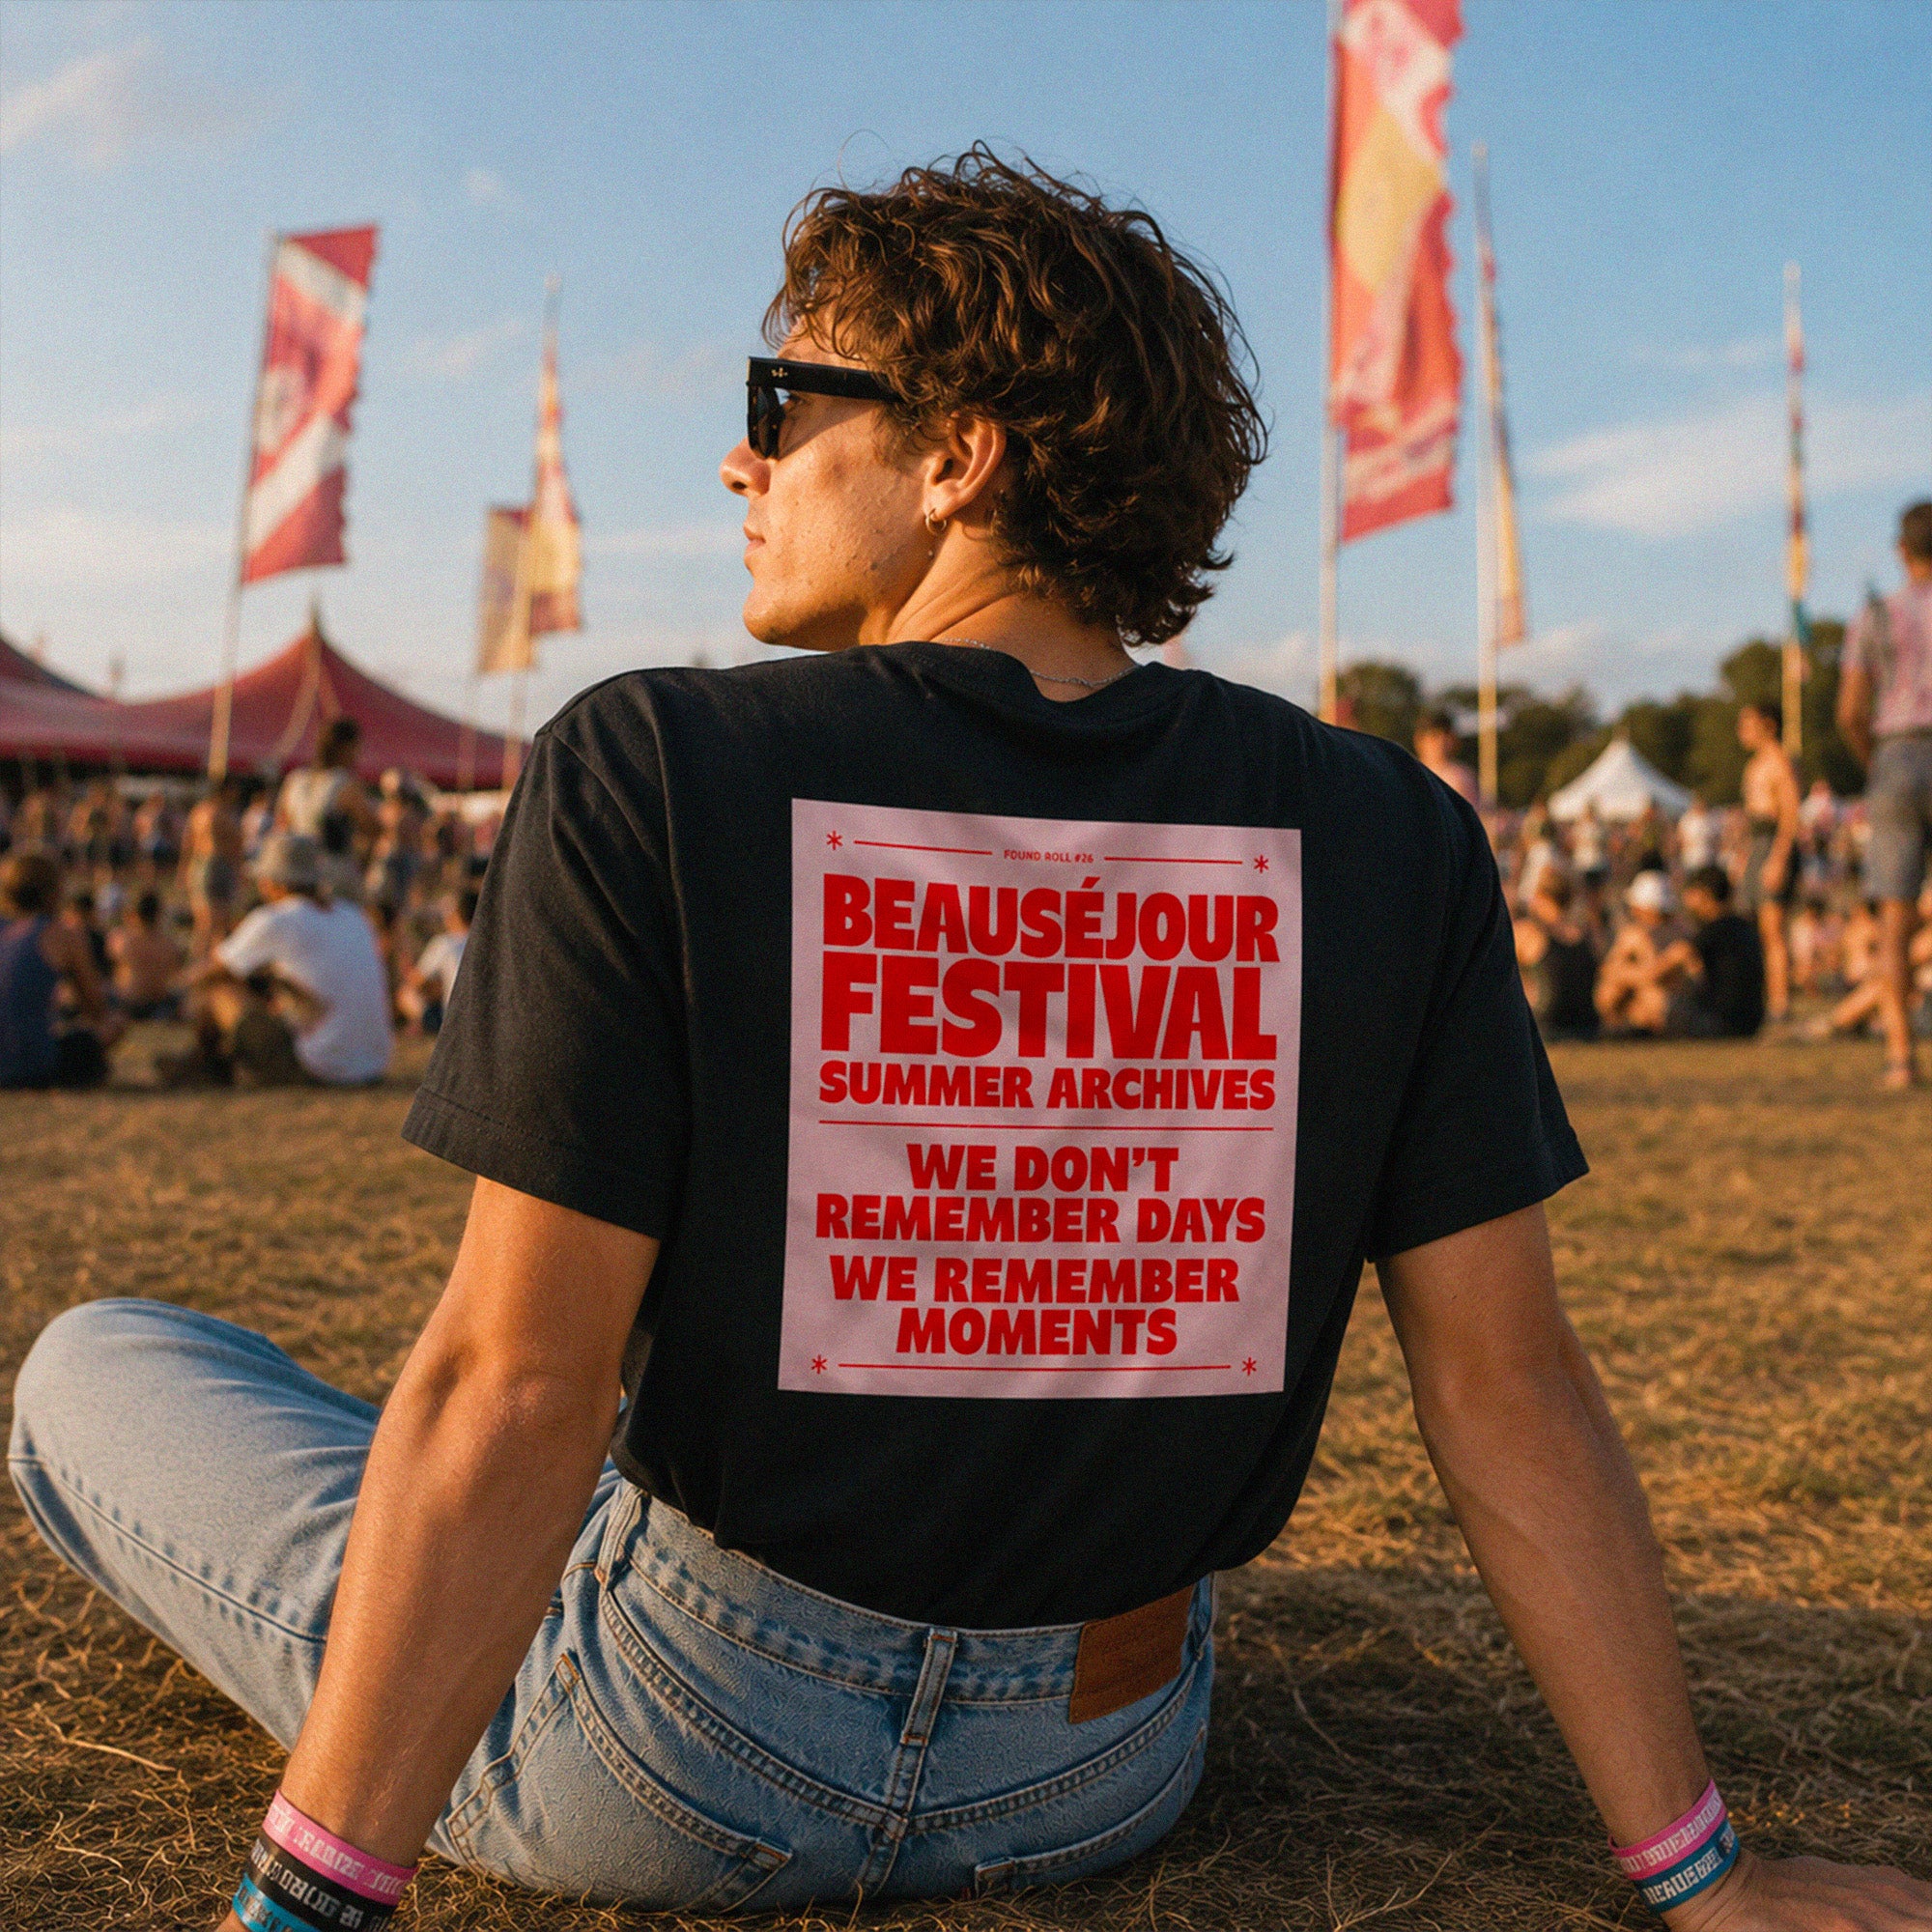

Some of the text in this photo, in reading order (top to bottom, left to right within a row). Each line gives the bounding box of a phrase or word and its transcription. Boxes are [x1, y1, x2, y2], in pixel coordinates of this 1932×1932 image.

[1004, 849, 1094, 864] FOUND ROLL #26
[822, 872, 1280, 963] BEAUSÉJOUR
[819, 951, 1277, 1061] FESTIVAL
[818, 1059, 1276, 1111] SUMMER ARCHIVES
[906, 1143, 1179, 1193] WE DON’T
[815, 1192, 1266, 1243] REMEMBER DAYS
[829, 1254, 1240, 1304] WE REMEMBER
[895, 1306, 1179, 1356] MOMENTS
